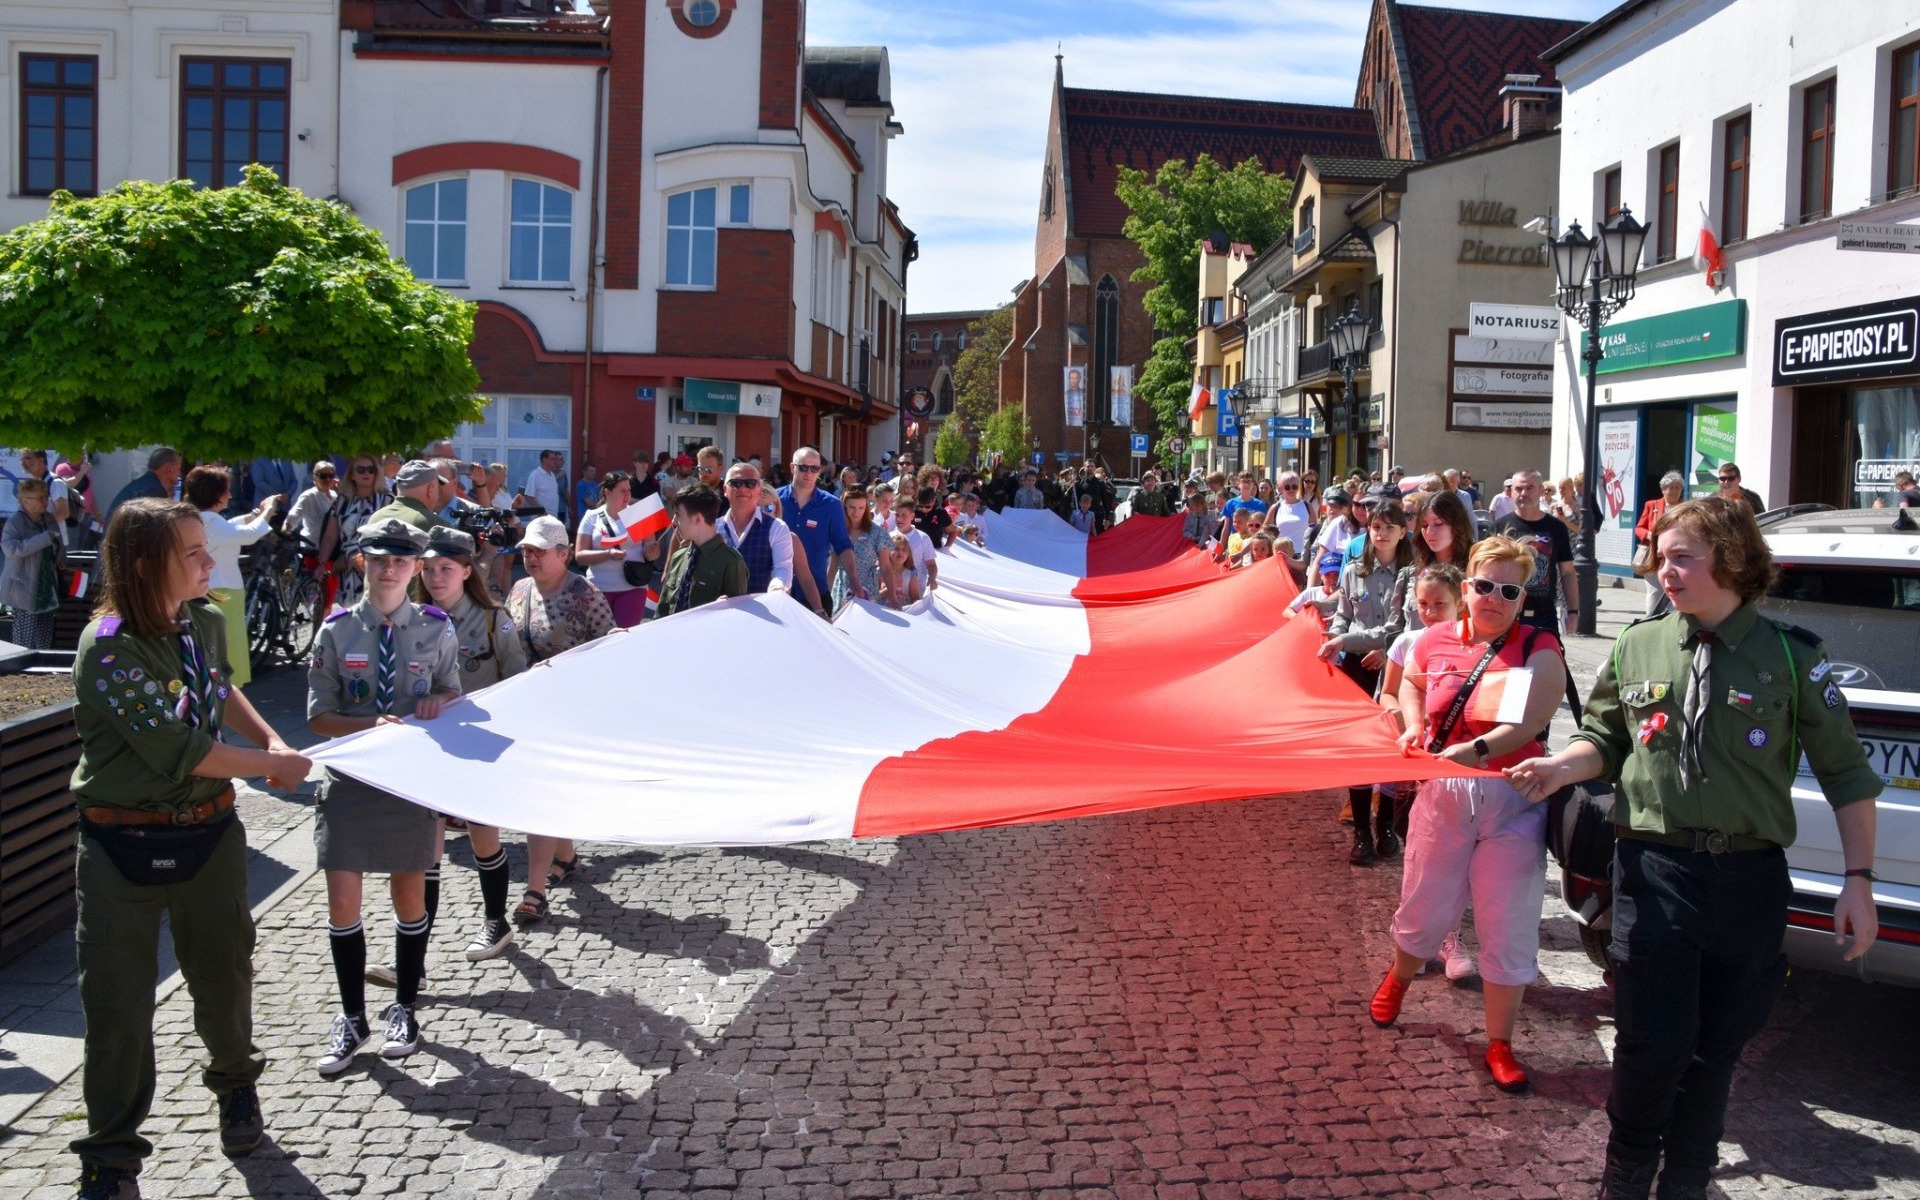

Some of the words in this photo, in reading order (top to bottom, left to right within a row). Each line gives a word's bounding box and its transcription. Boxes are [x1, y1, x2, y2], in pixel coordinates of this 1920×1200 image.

[1459, 200, 1517, 227] Willa
[1856, 225, 1891, 236] AVENUE
[1841, 239, 1865, 249] gabinet
[1866, 239, 1906, 250] kosmetyczny
[1457, 239, 1546, 267] Pierrot
[1474, 315, 1559, 330] NOTARIUSZ
[1608, 333, 1627, 346] KASA
[1786, 321, 1908, 365] E-PAPIEROSY.PL
[1500, 370, 1550, 383] Fotografia
[1222, 414, 1235, 432] P
[1135, 436, 1145, 449] P
[1466, 652, 1493, 686] VERSOLI
[1443, 695, 1466, 731] VERSOLI
